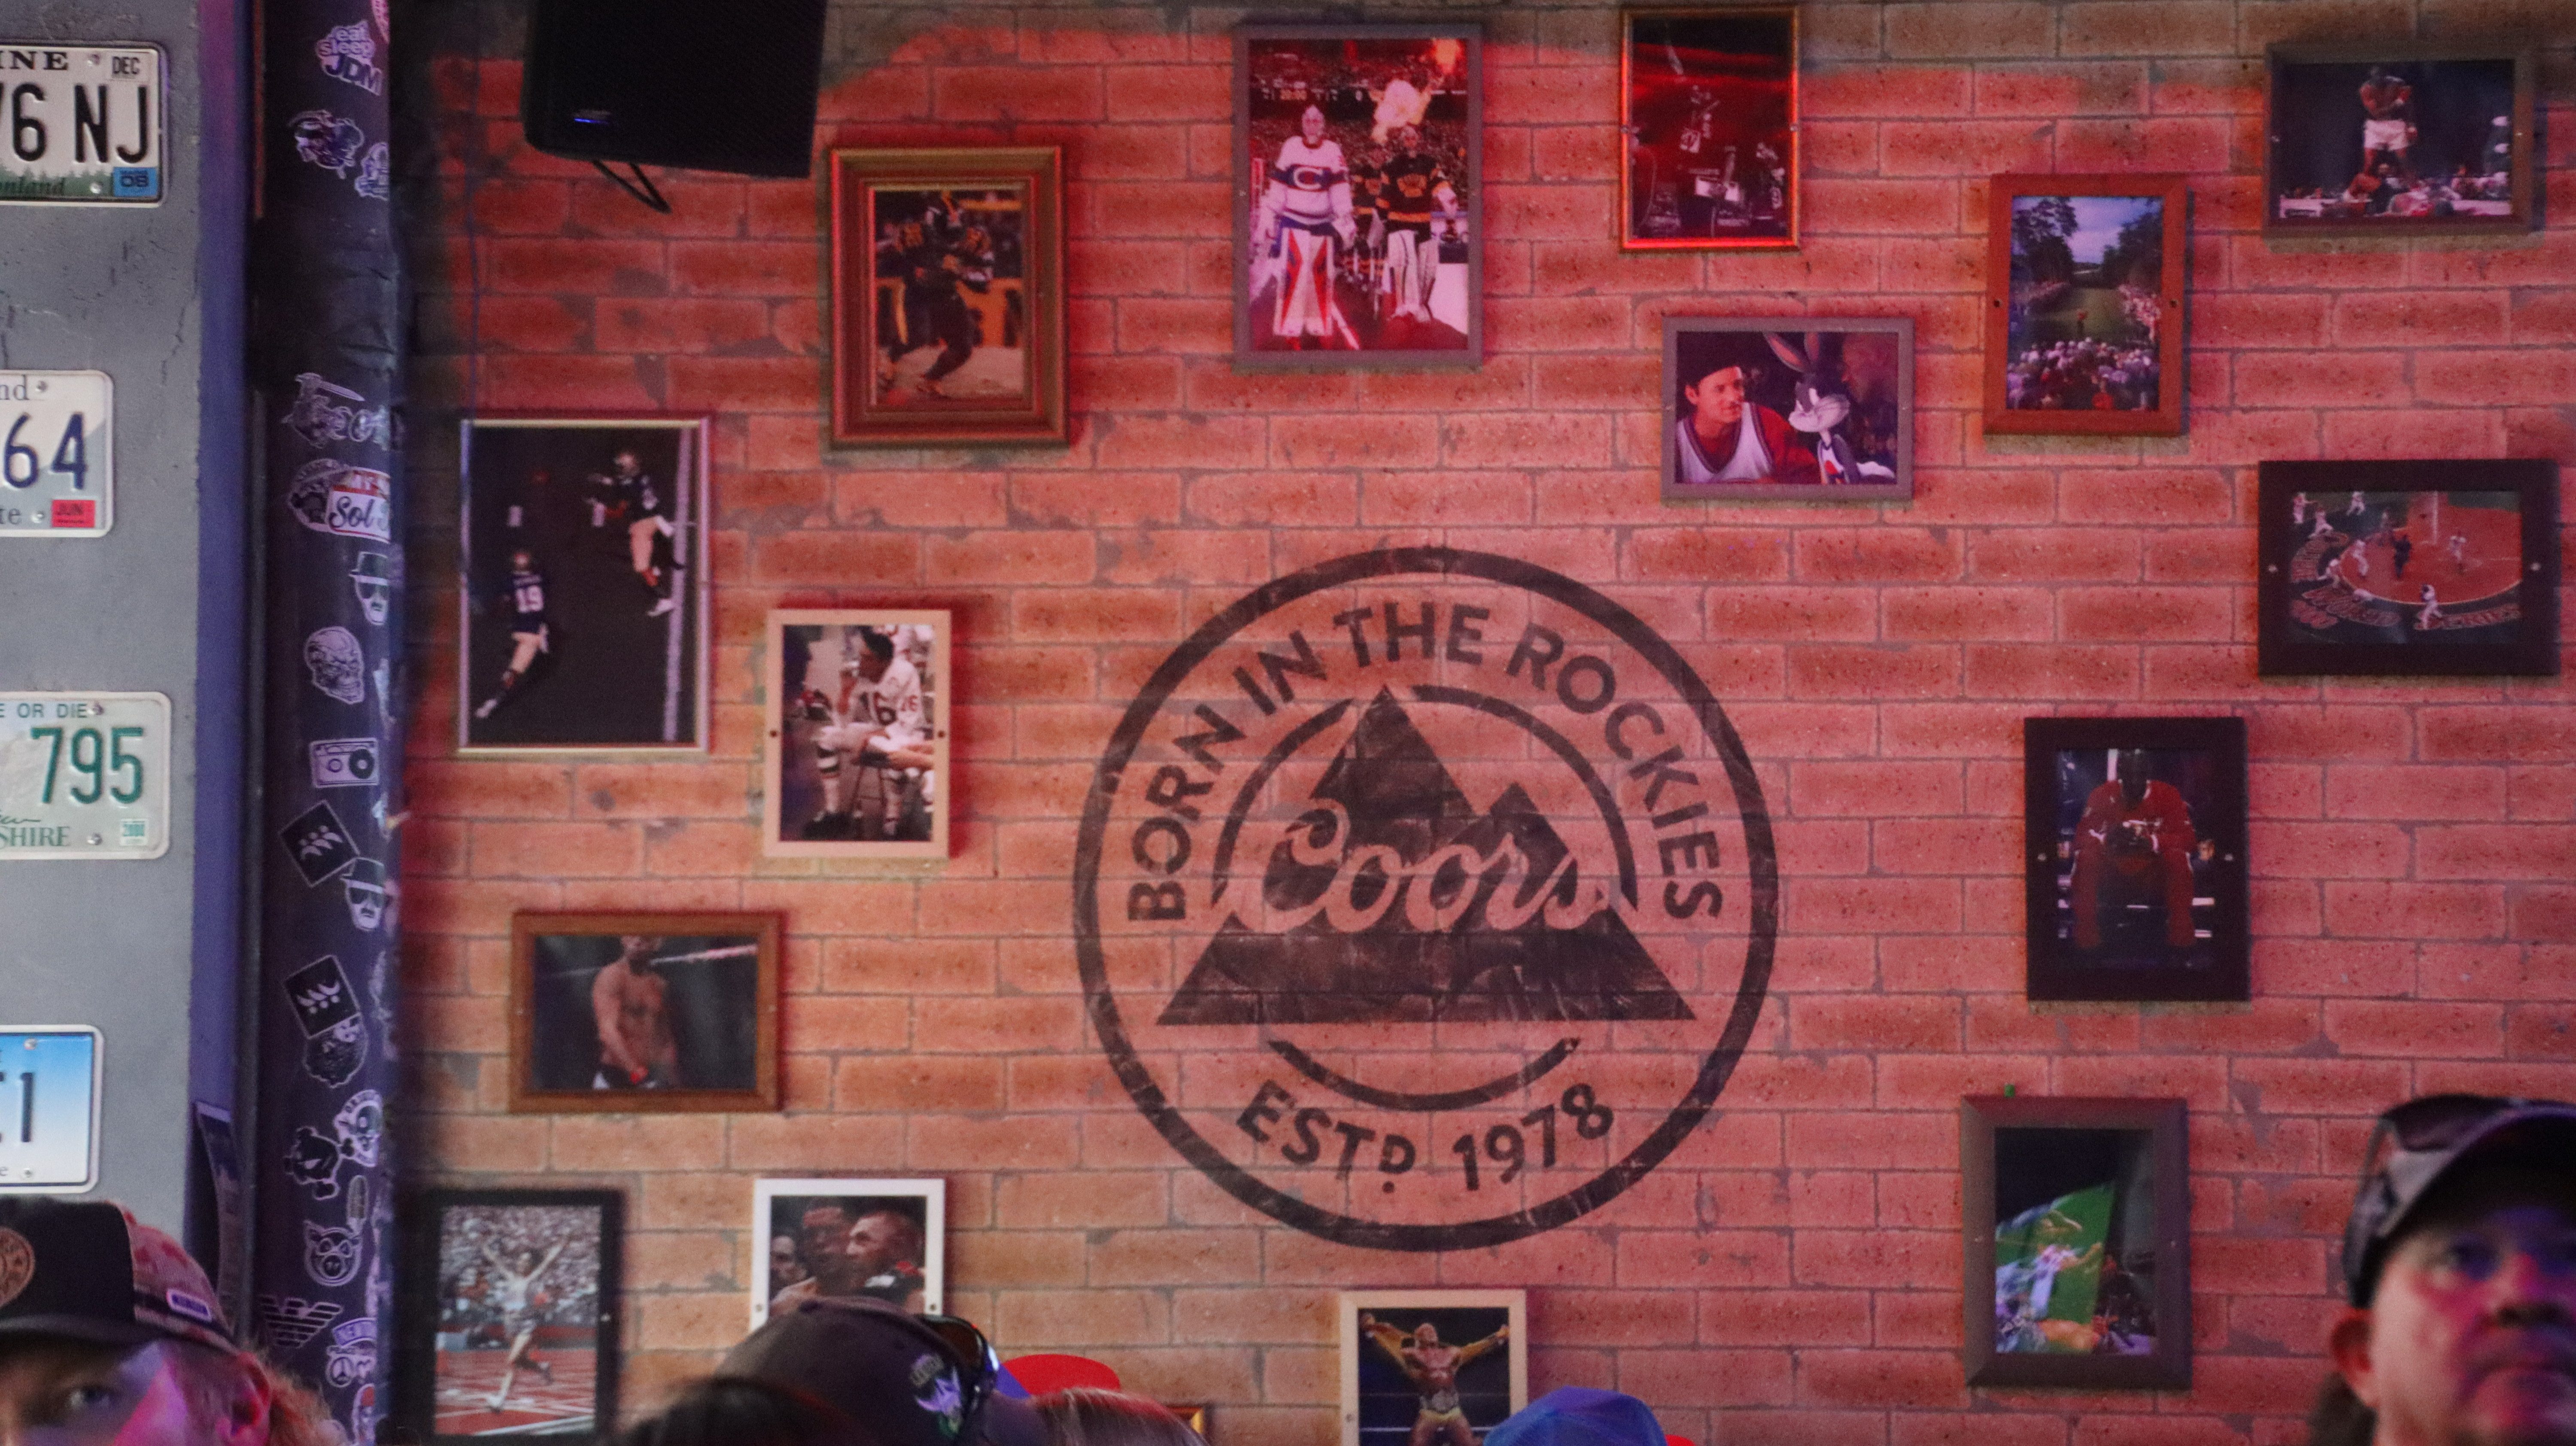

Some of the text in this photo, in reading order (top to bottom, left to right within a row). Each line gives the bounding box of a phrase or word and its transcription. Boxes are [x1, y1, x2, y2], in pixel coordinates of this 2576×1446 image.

[318, 38, 372, 57] sleep
[335, 23, 365, 42] eat
[0, 51, 68, 70] NE
[112, 56, 140, 75] DEC
[325, 52, 381, 94] JDM
[0, 82, 149, 164] 6 NJ
[0, 176, 65, 195] nland
[3, 412, 89, 490] 64
[328, 495, 375, 528] Sol
[18, 703, 44, 718] OR
[57, 703, 88, 718] DIE
[30, 727, 144, 804] 795
[1127, 600, 1722, 922] BORN IN THE ROCKIES
[1230, 797, 1611, 934] Coors
[0, 1072, 34, 1142] 1
[1452, 1082, 1615, 1191] 1978
